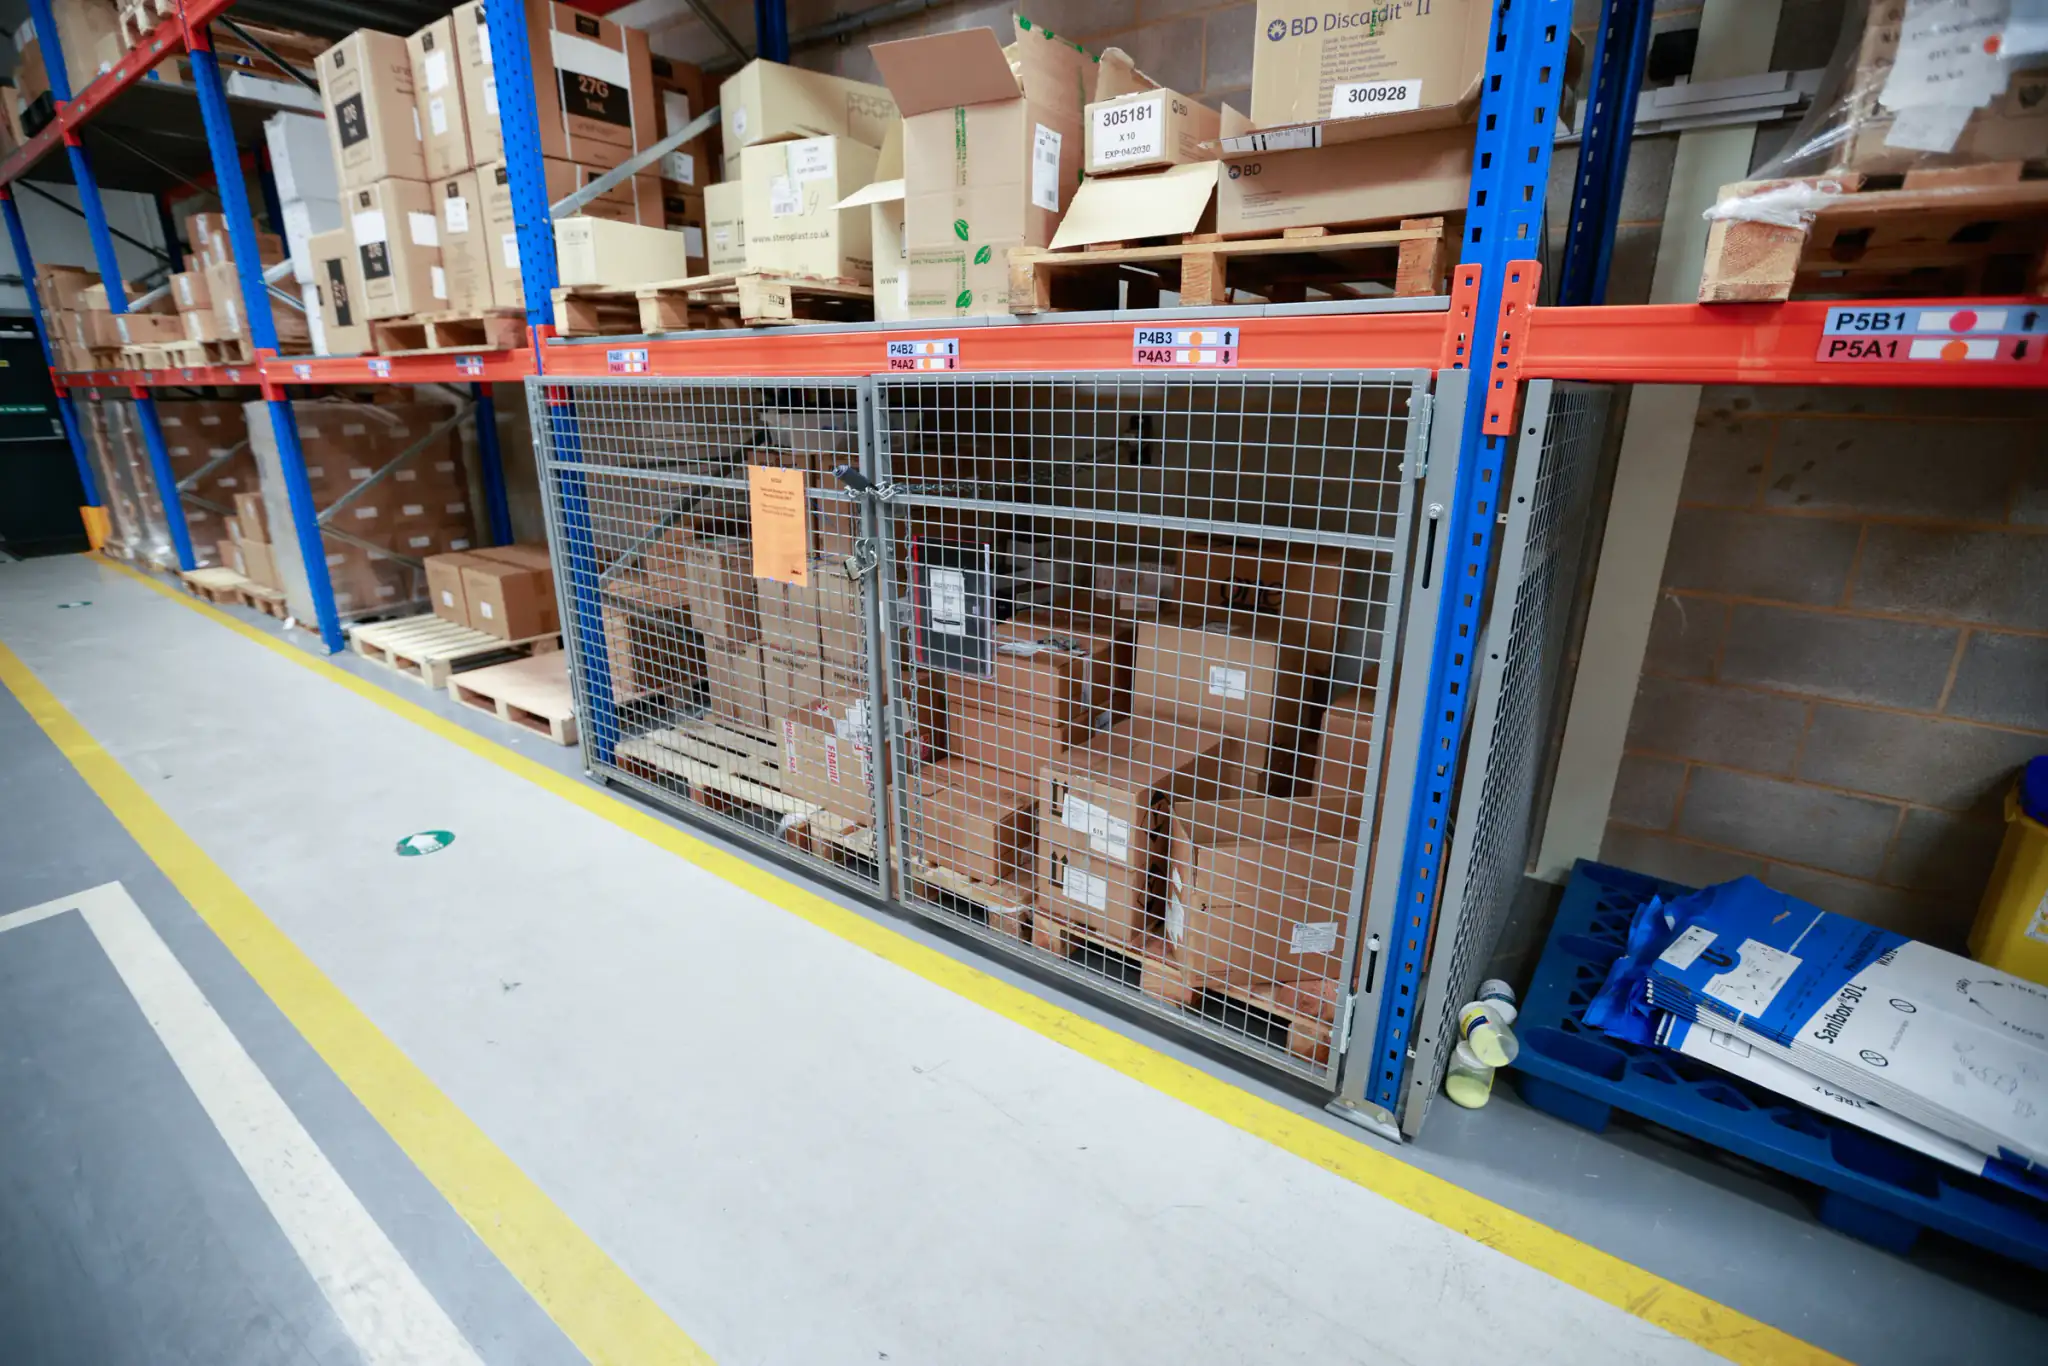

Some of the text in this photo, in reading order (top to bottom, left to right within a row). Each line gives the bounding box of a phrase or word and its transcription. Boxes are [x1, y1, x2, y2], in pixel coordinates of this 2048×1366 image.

[1290, 16, 1318, 37] BD
[578, 75, 608, 98] 27G
[1348, 86, 1406, 103] 300928
[1103, 104, 1152, 127] 305181
[1127, 132, 1136, 140] 10
[1244, 163, 1262, 176] BD
[752, 230, 830, 244] www.steroplast.co.uk
[1835, 312, 1906, 330] P5B1
[1139, 332, 1172, 344] P4B3
[890, 344, 914, 354] P4B2
[1138, 350, 1171, 362] P4A3
[1828, 340, 1898, 358] P5A1
[891, 359, 914, 369] P4A2
[1840, 986, 1863, 1004] 50
[1812, 1084, 1866, 1110] TREAT
